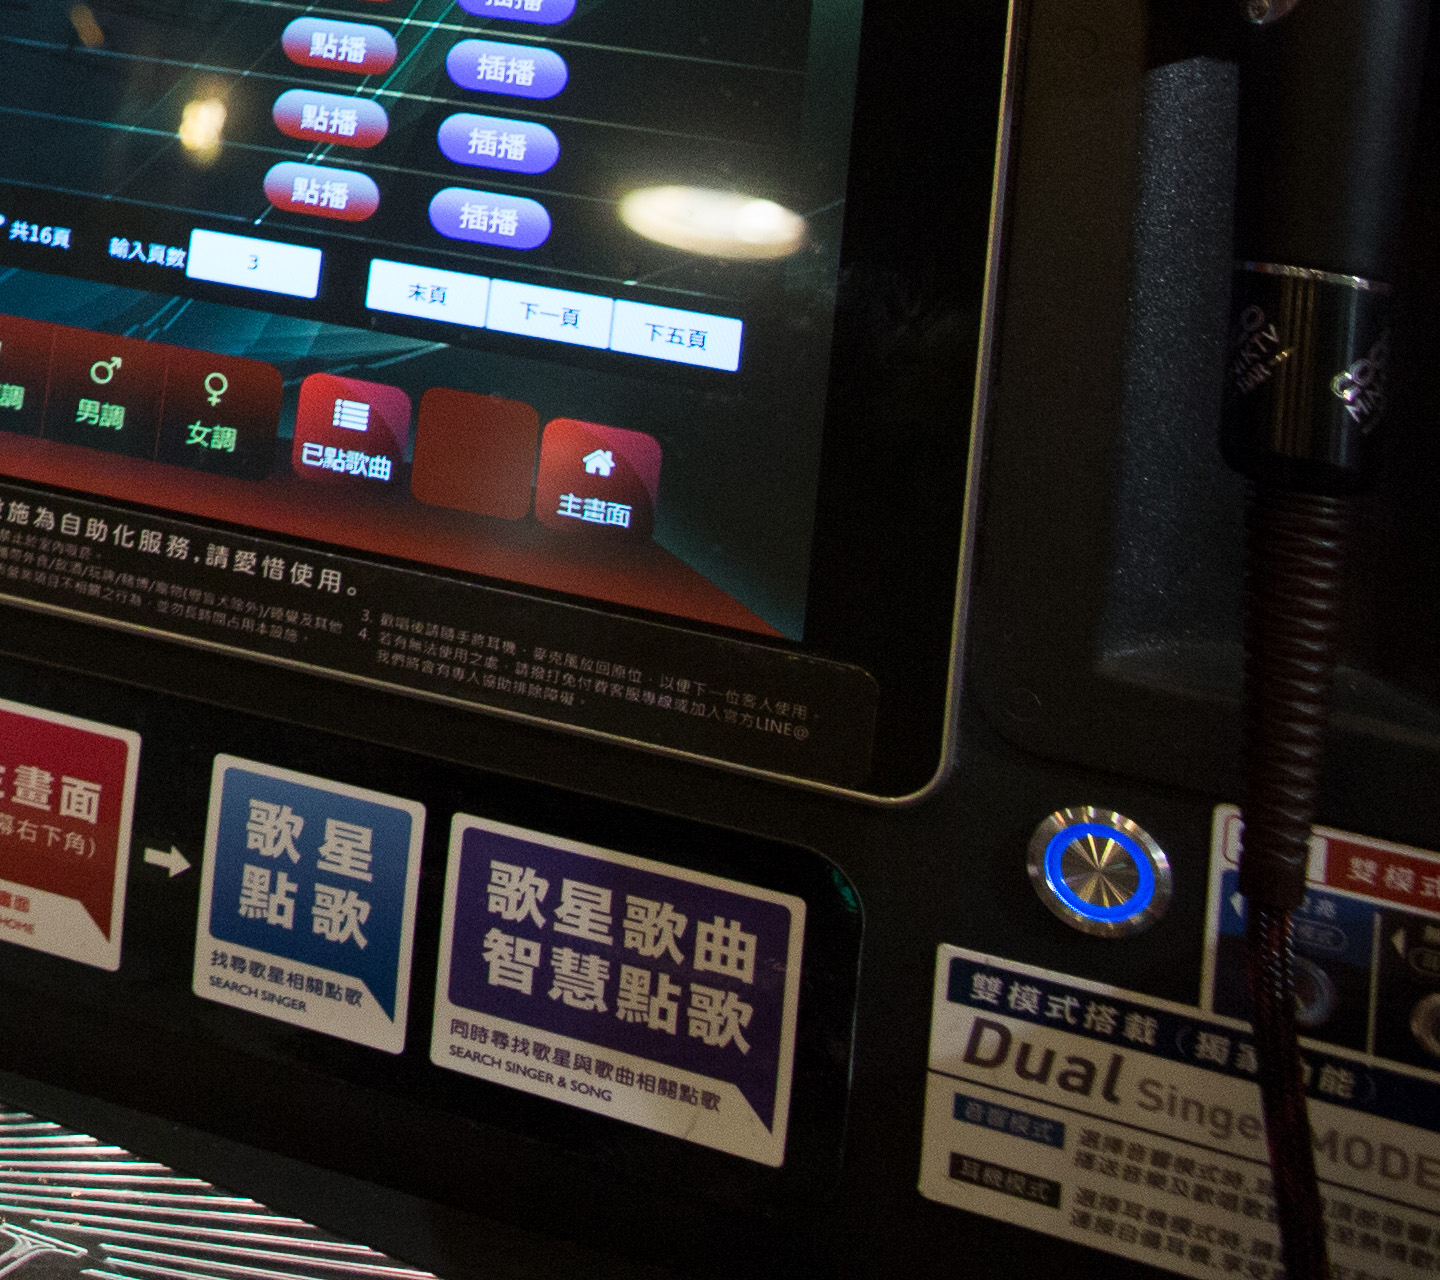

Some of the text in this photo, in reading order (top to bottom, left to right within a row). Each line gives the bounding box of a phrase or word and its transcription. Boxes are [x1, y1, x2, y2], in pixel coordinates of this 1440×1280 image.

[310, 31, 367, 63] 點播
[477, 54, 535, 86] 插播
[301, 103, 358, 135] 點播
[468, 129, 527, 161] 插播
[292, 176, 349, 208] 點播
[459, 202, 518, 235] 插播
[9, 220, 260, 271] 共16頁 輸入頁數 3
[406, 281, 708, 352] 末頁 下一頁 下五頁
[76, 396, 126, 432] 男調
[187, 419, 238, 454] 女調
[301, 439, 392, 482] 已點歌曲
[557, 491, 633, 529] 主畫面
[245, 796, 375, 884] 歌星
[237, 862, 372, 951] 點歌
[486, 858, 759, 986] 歌星歌曲
[208, 973, 308, 1014] SEARCH SINGER
[210, 947, 364, 1009] 找尋歌星相關點歌
[482, 927, 755, 1057] 智慧點歌
[968, 972, 1160, 1047] 雙模式搭載
[449, 1044, 614, 1103] SEARCH SINGER & SONG
[450, 1017, 722, 1115] 同時尋找歌星與歌曲相關點歌
[961, 1015, 1125, 1107] Dual
